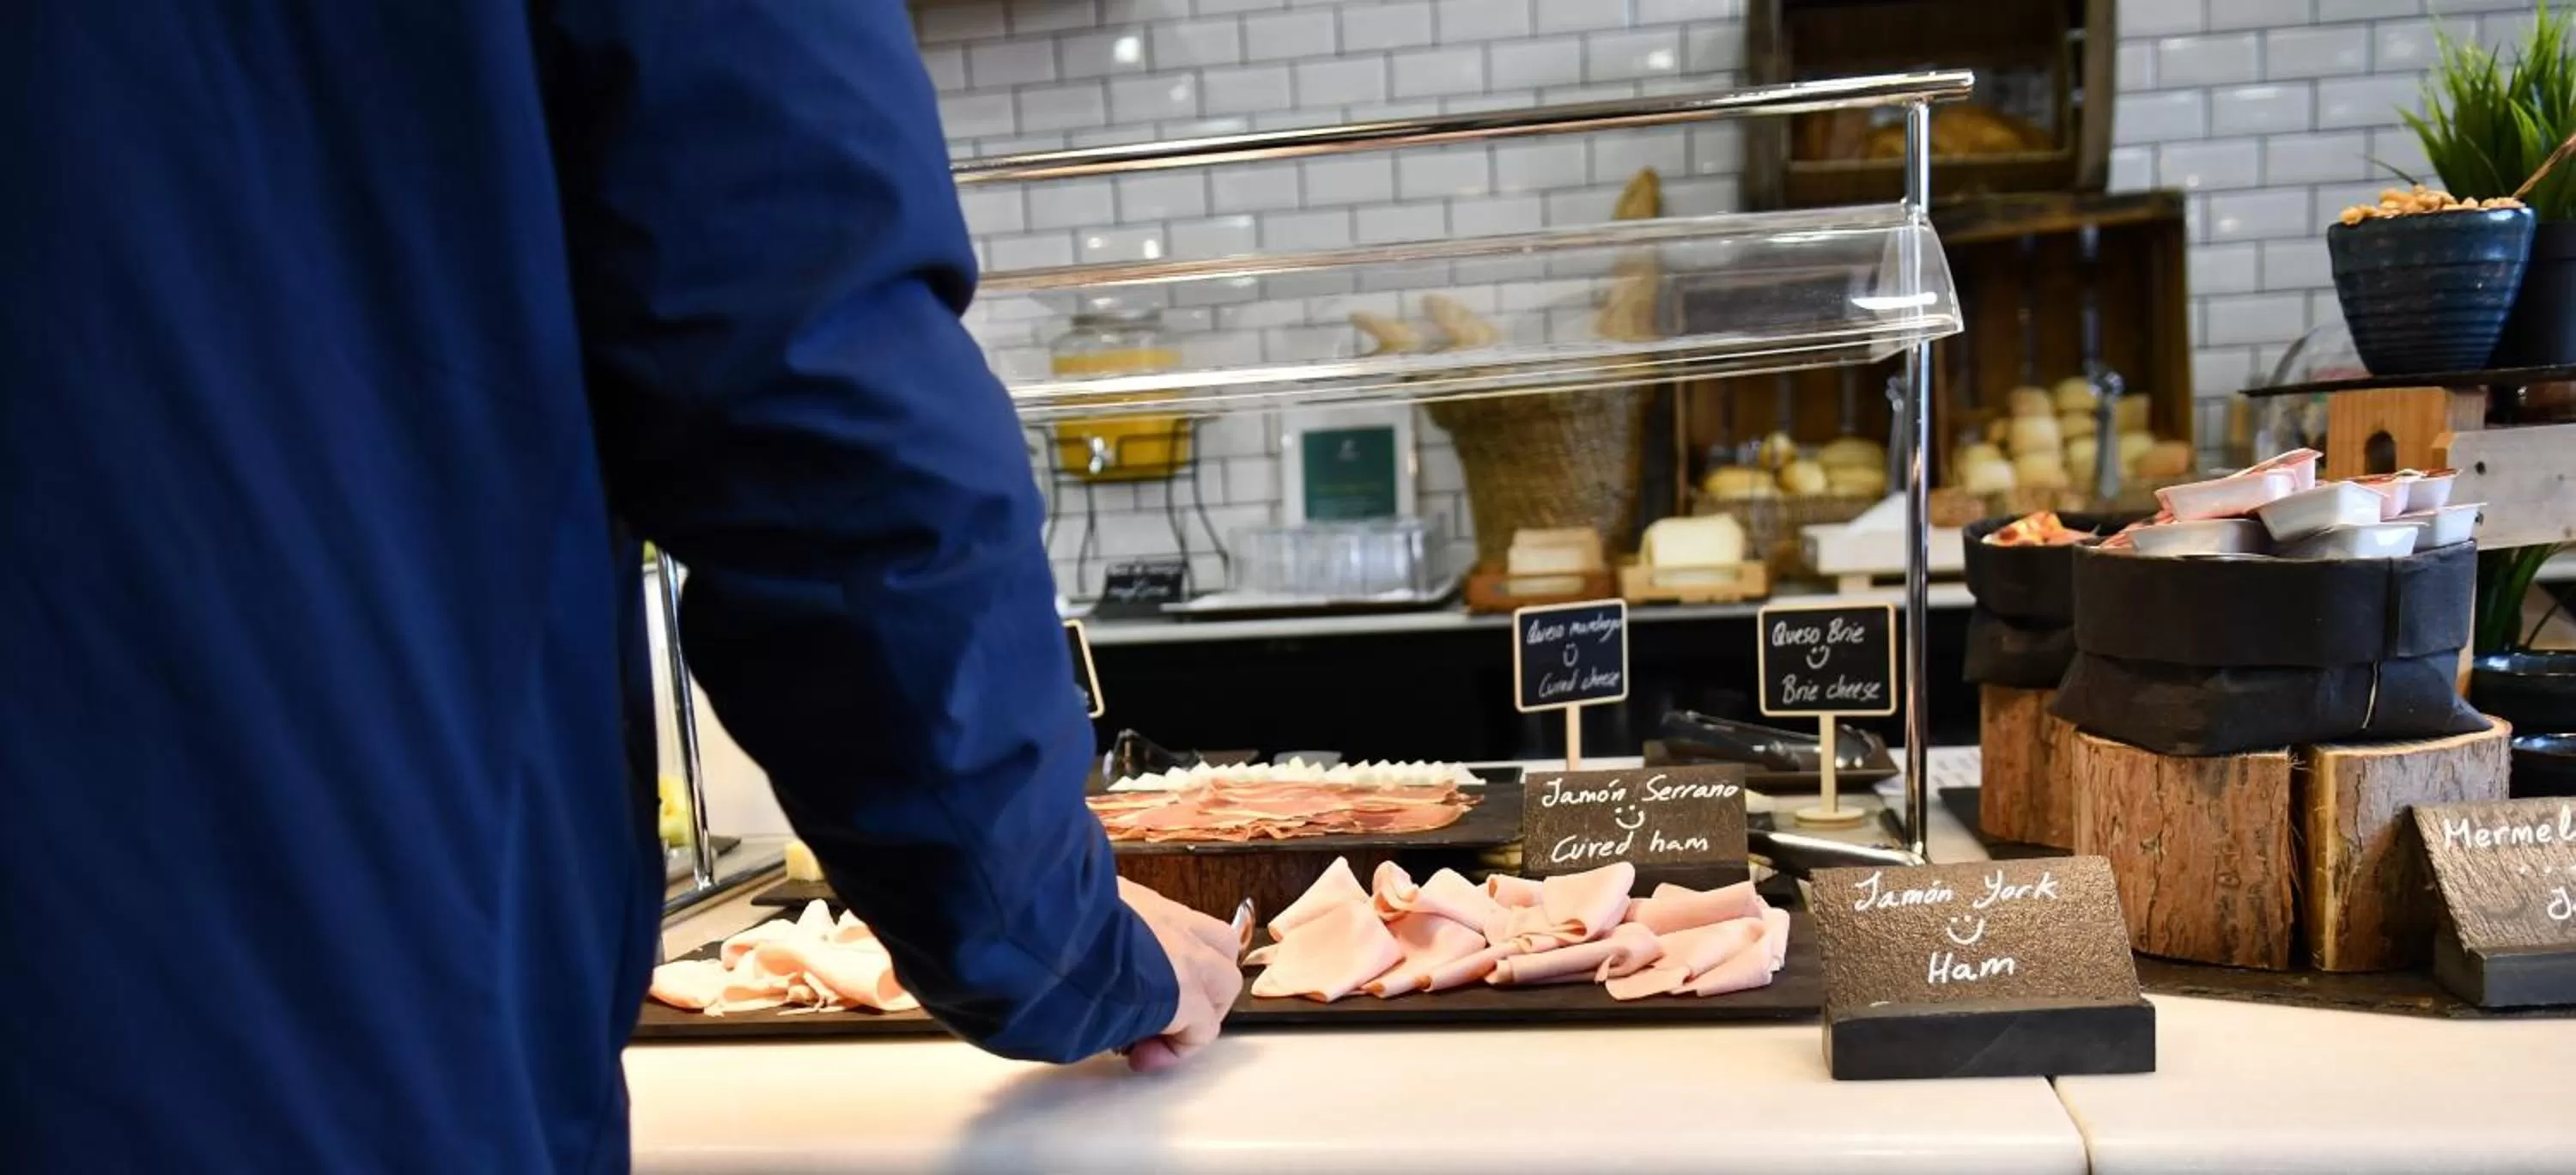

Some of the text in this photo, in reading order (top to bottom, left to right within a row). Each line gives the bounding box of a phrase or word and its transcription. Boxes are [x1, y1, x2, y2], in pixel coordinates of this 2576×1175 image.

[1771, 616, 1865, 646] Queso Brie
[1782, 673, 1881, 704] Brie cheese
[1542, 774, 1740, 807] Jamón Serrano
[1551, 830, 1710, 862] Cured ham
[1855, 869, 2059, 911] Jamón York
[1928, 951, 2016, 984] Ham
